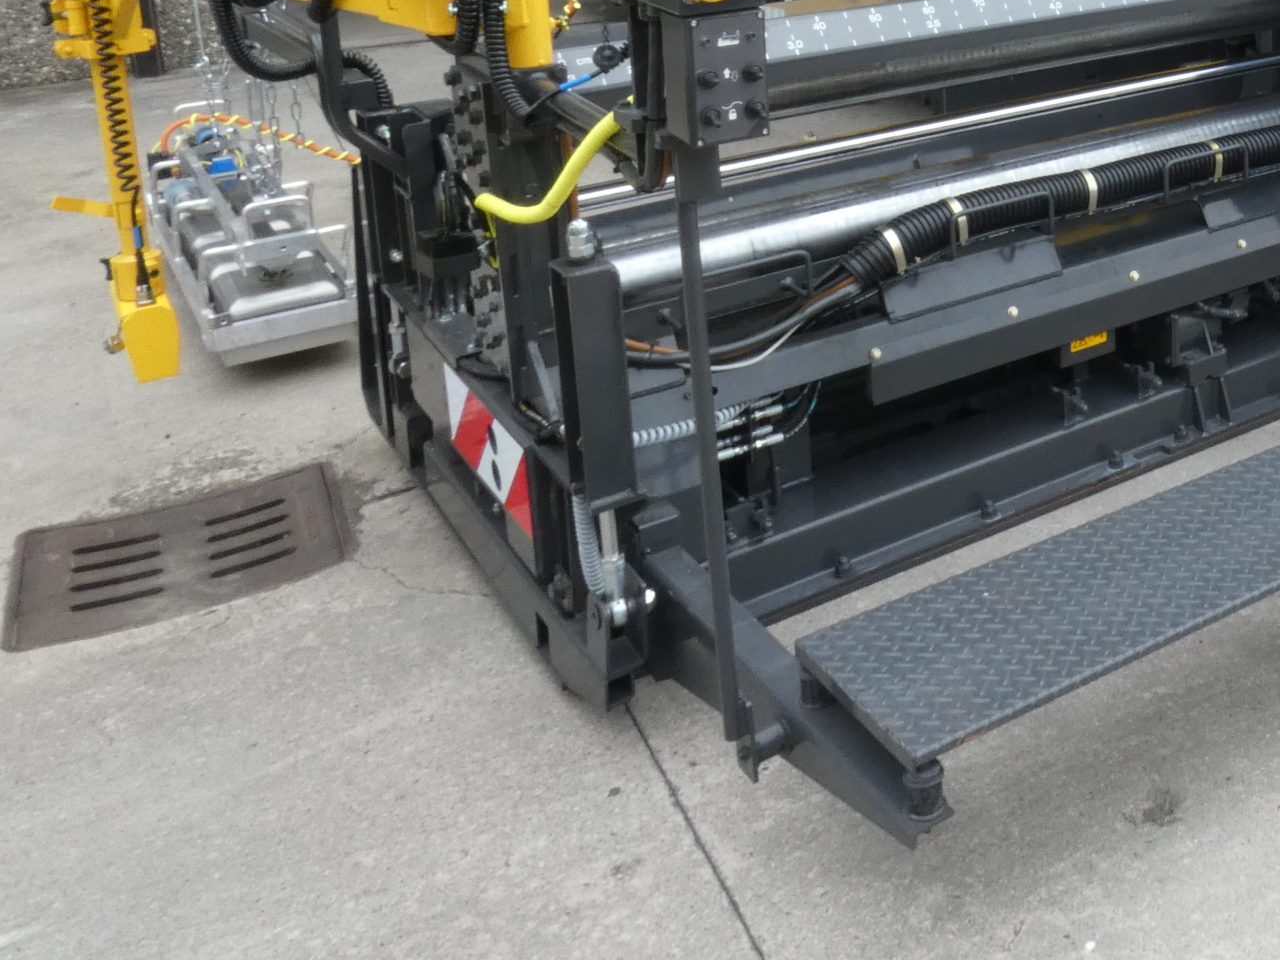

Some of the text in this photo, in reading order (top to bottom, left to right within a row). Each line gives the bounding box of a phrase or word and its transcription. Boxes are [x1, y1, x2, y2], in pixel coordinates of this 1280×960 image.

[813, 20, 827, 31] 40
[868, 12, 883, 23] 50
[786, 39, 804, 50] 3.0
